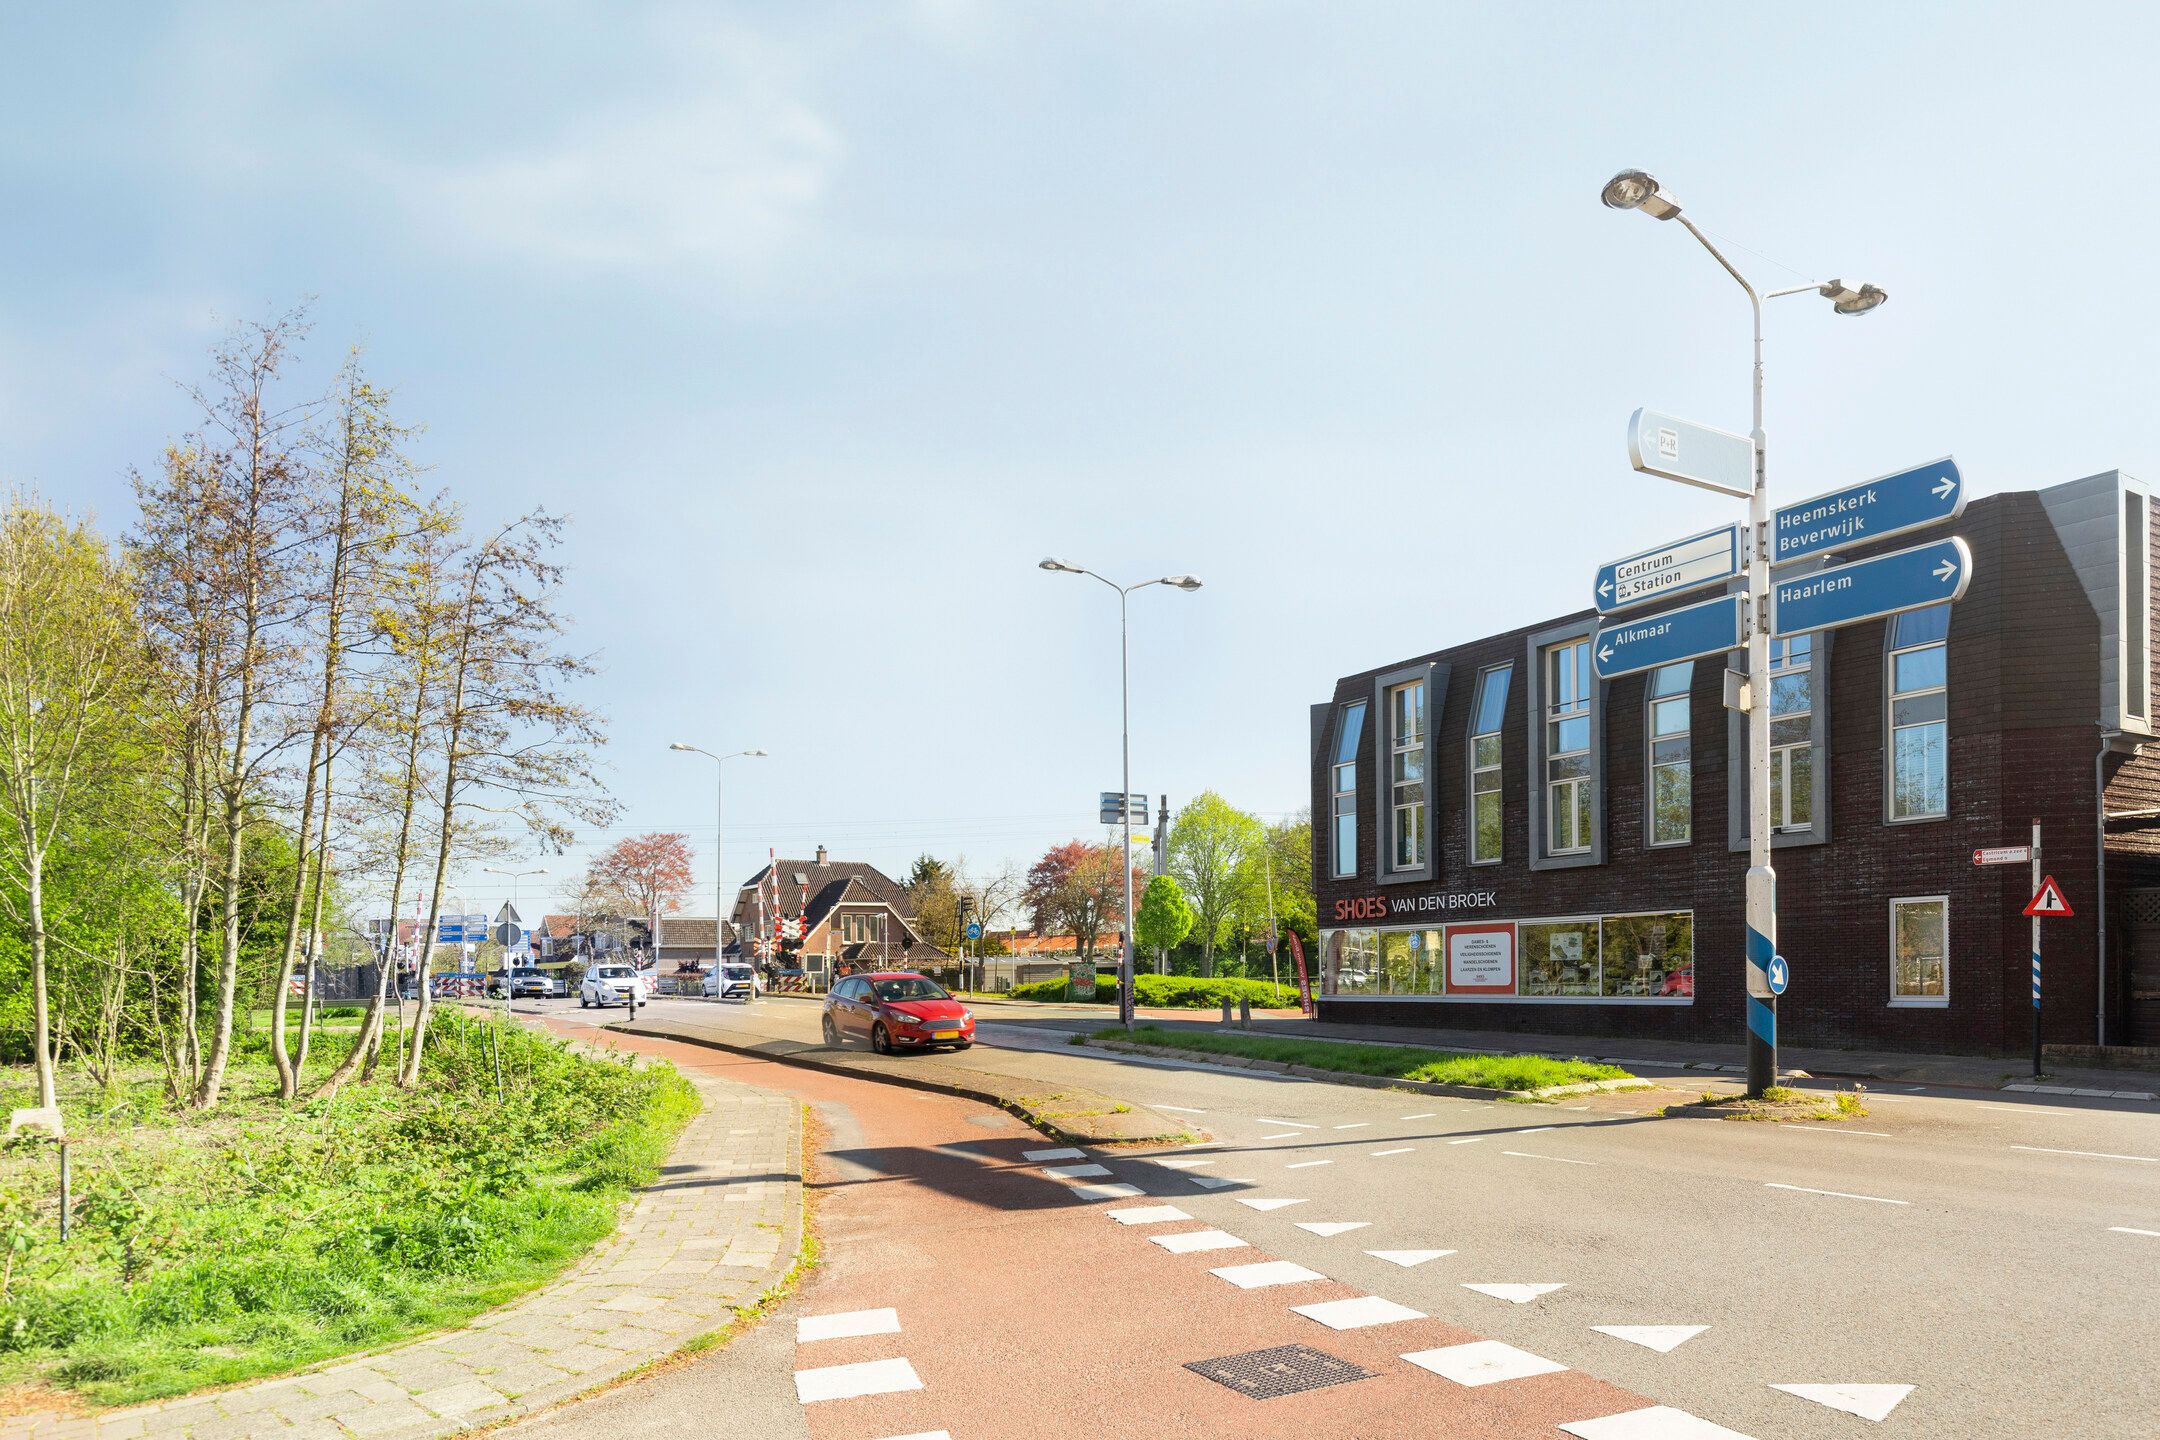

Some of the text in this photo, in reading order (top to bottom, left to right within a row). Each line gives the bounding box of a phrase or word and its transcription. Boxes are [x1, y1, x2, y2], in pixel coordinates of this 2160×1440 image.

[1660, 436, 1676, 451] P+R
[1780, 489, 1877, 530] Heemskerk
[1780, 516, 1865, 552] Beverwijk
[1618, 554, 1673, 579] Centrum
[1633, 571, 1681, 594] Station
[1781, 576, 1852, 603] Haarlem
[1615, 622, 1672, 646] Alkmaar
[1334, 891, 1497, 921] SHOES VAN DEN BROEK
